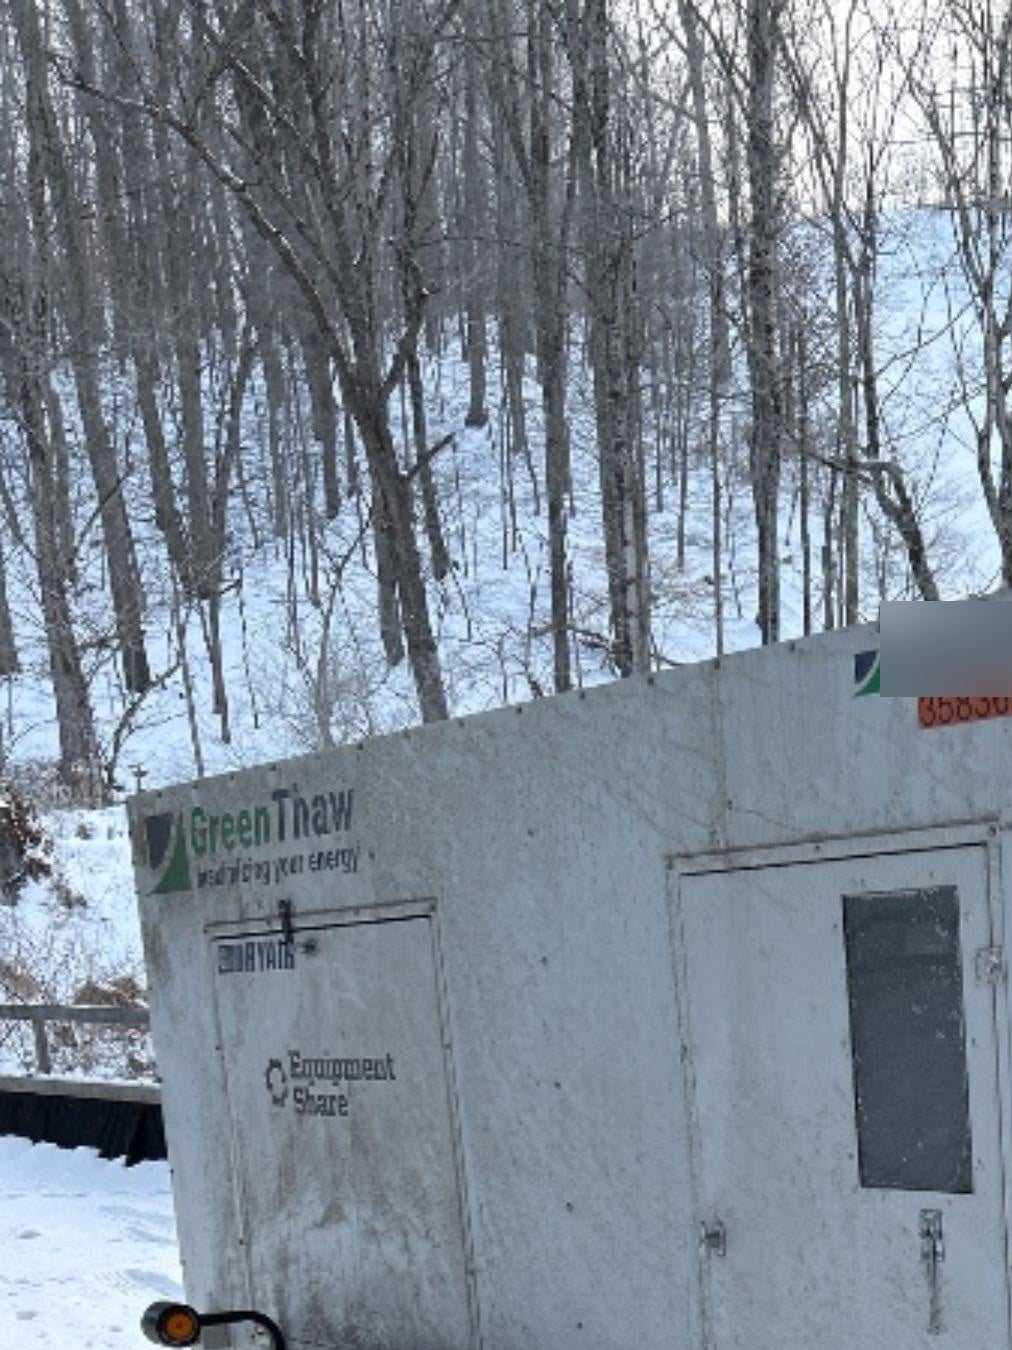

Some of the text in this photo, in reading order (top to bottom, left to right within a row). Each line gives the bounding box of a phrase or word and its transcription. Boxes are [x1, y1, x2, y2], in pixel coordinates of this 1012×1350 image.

[191, 788, 355, 856] GreenThaw
[307, 846, 359, 874] energy
[287, 1049, 397, 1087] Equipment
[292, 1086, 349, 1117] Share
